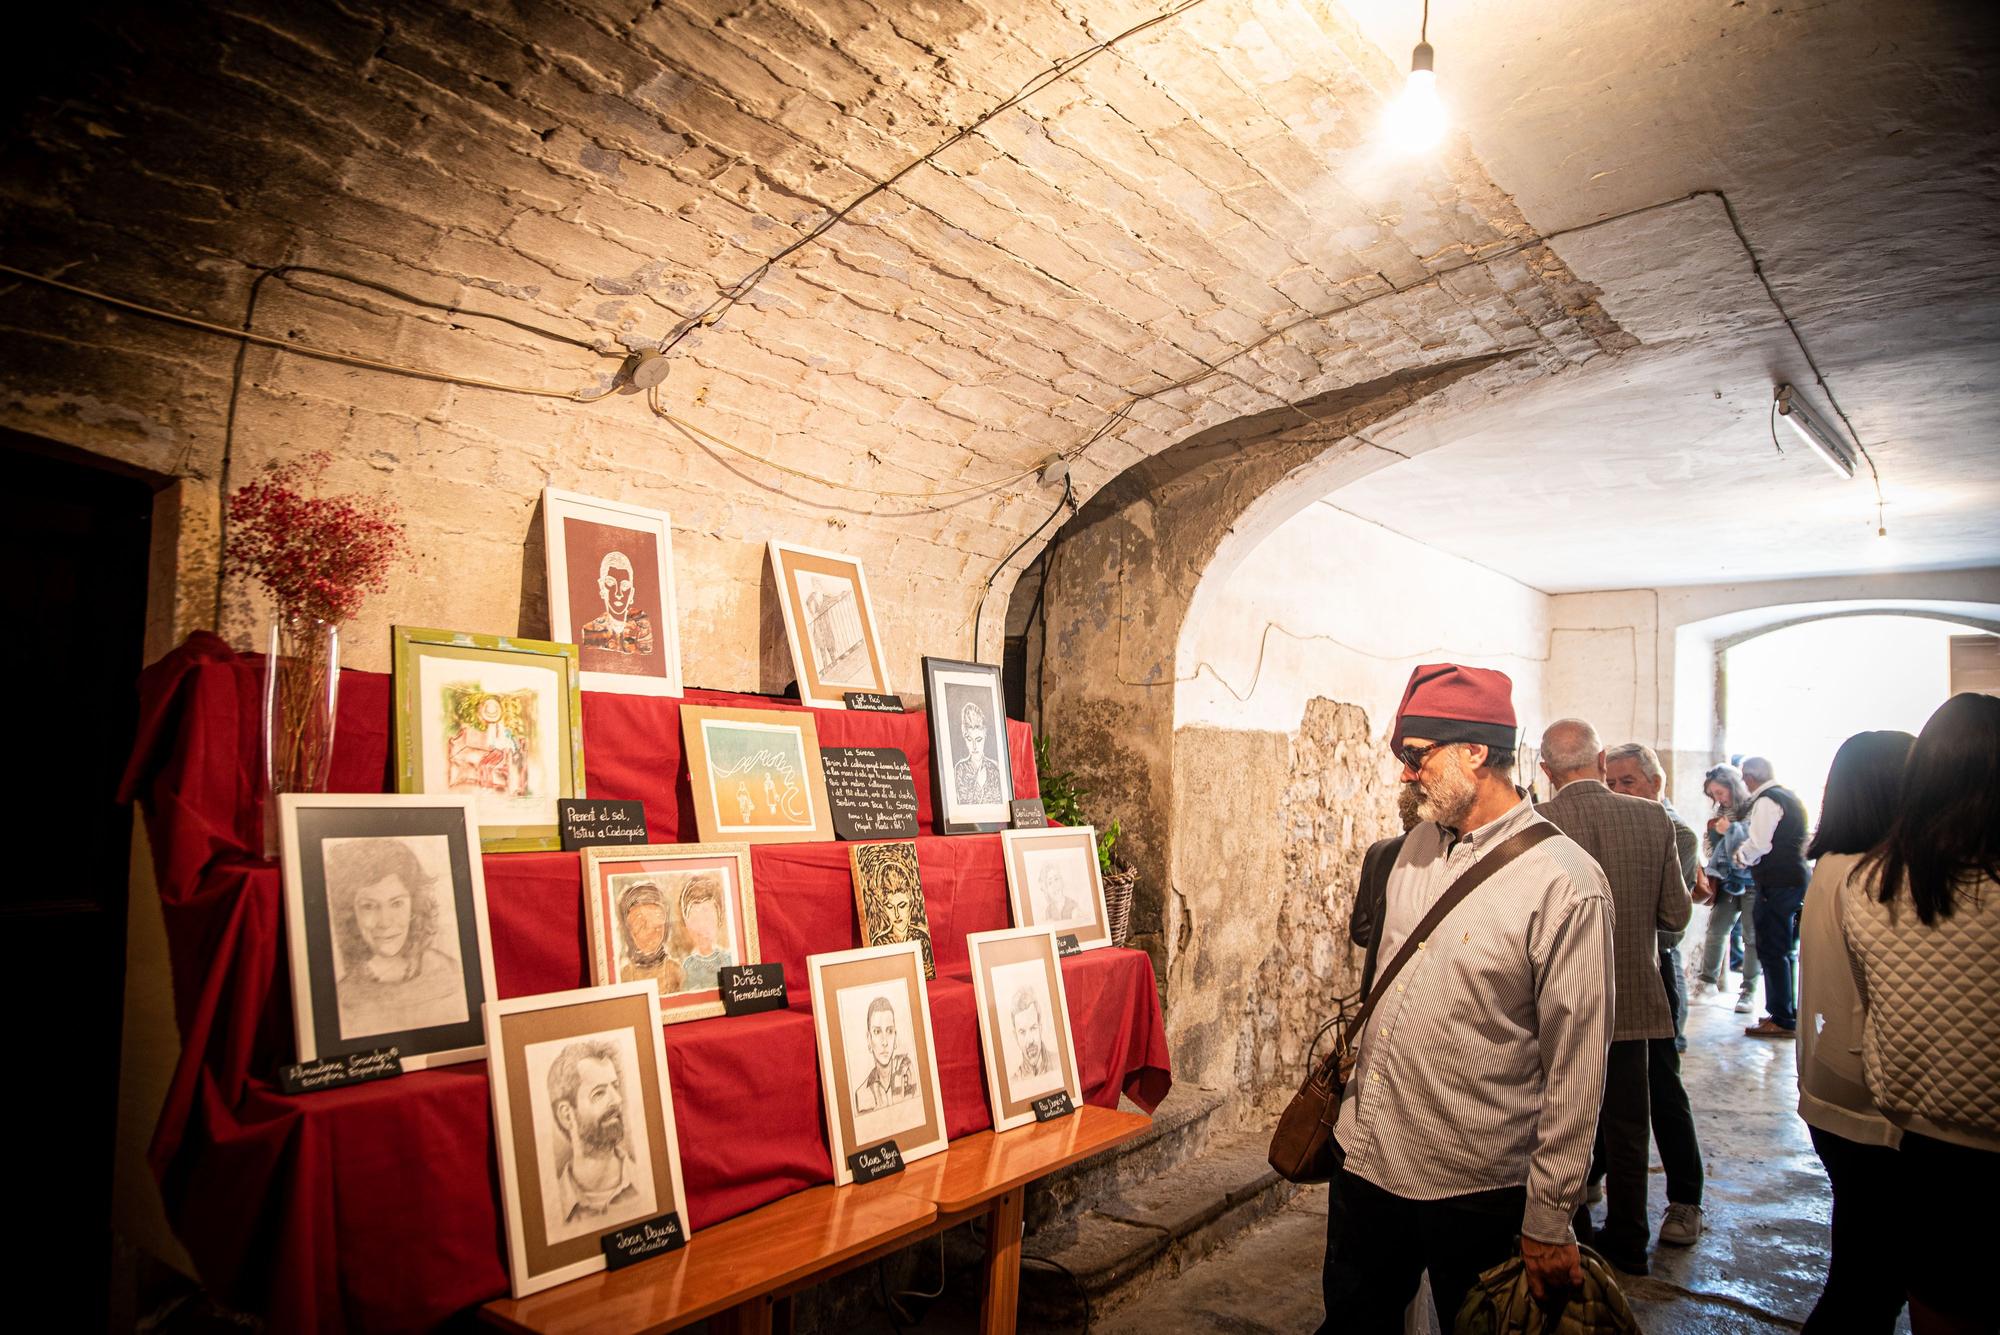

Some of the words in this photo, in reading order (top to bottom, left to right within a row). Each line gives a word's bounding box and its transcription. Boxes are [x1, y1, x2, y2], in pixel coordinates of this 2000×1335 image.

[868, 694, 881, 704] Picó
[843, 748, 854, 756] La
[855, 748, 876, 757] Sirena
[835, 797, 857, 808] Sentim
[885, 801, 894, 810] la
[599, 807, 610, 821] el
[597, 829, 606, 838] a
[605, 824, 645, 843] Cadaqués
[732, 974, 764, 987] Dones
[616, 1231, 644, 1249] Joan
